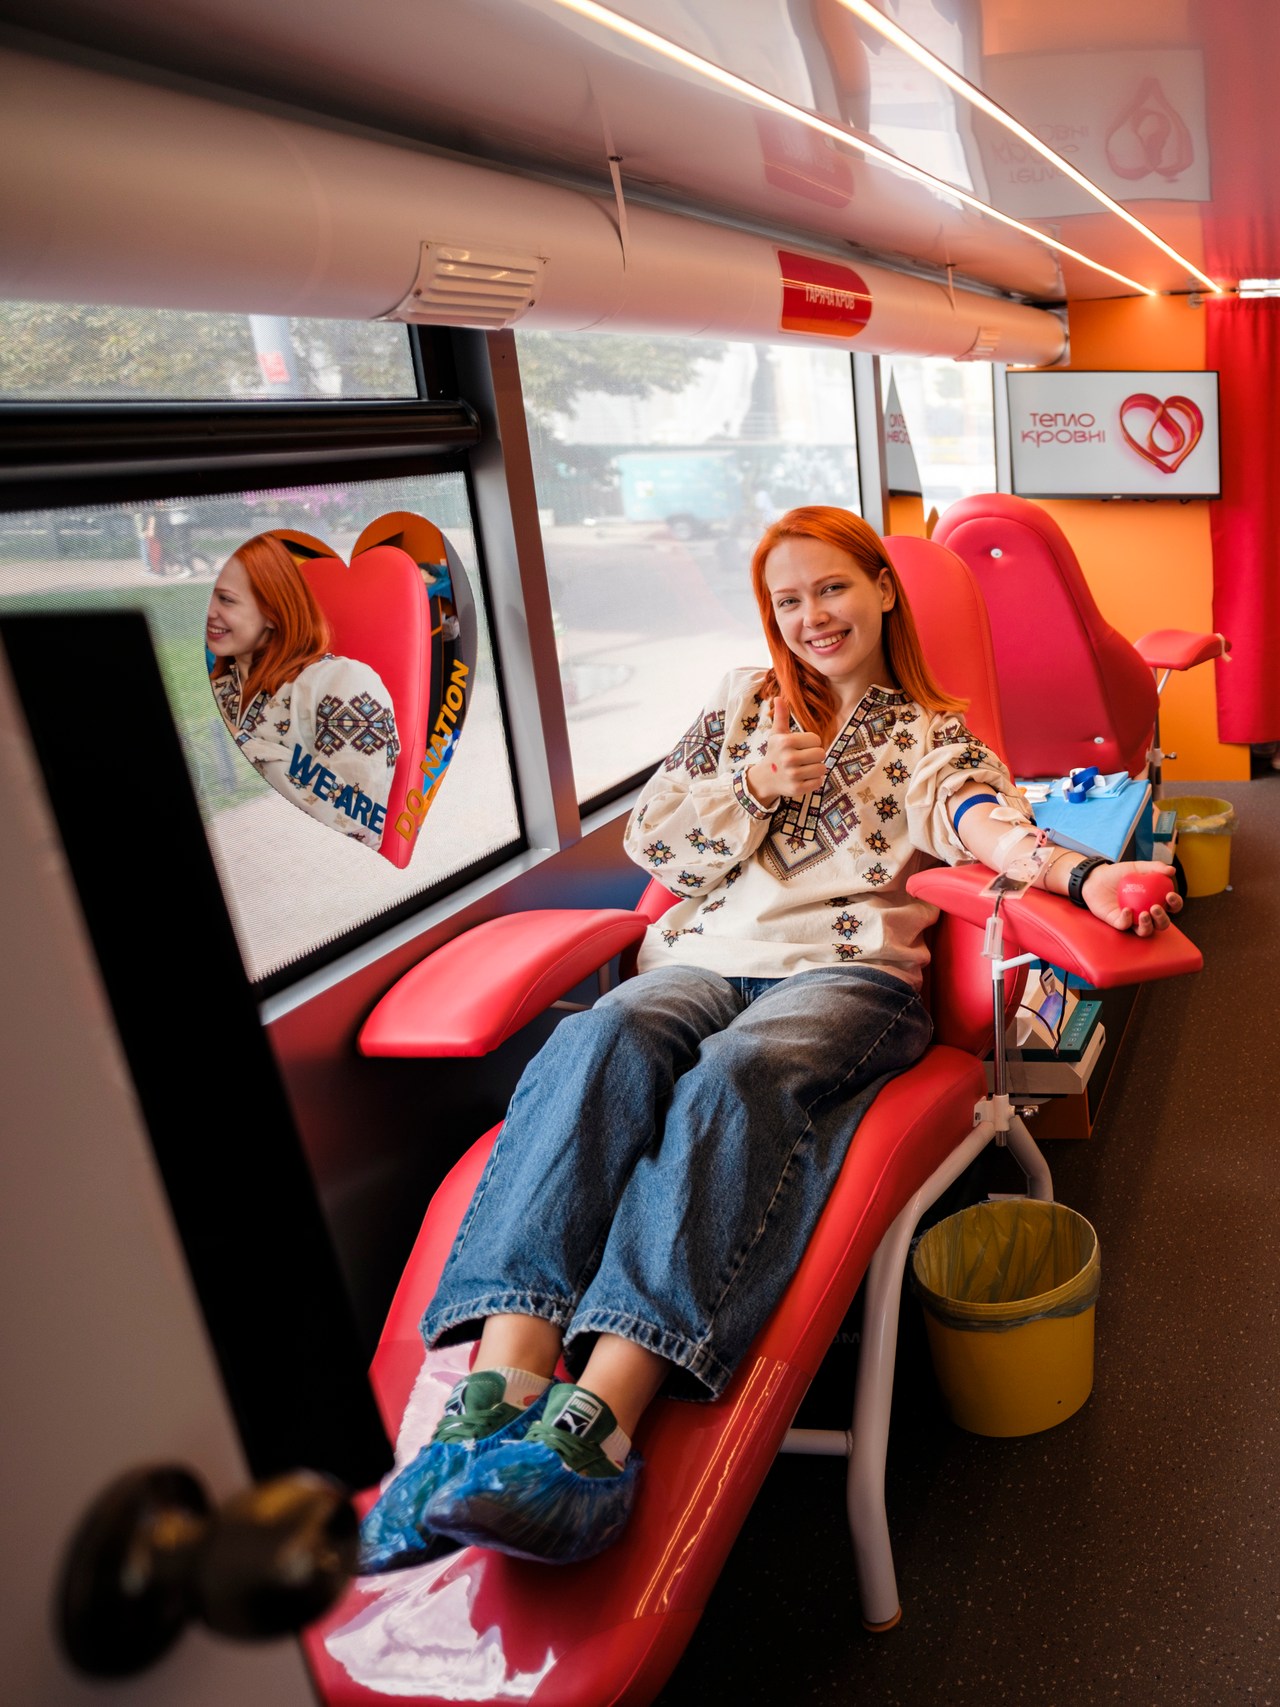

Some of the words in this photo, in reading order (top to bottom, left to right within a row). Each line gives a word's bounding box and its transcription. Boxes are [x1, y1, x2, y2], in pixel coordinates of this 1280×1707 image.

[805, 284, 835, 306] ГАРЯЧА
[835, 291, 855, 310] КРОВ
[289, 743, 336, 801] WE
[333, 784, 388, 835] ARE
[571, 1397, 598, 1417] PUMA
